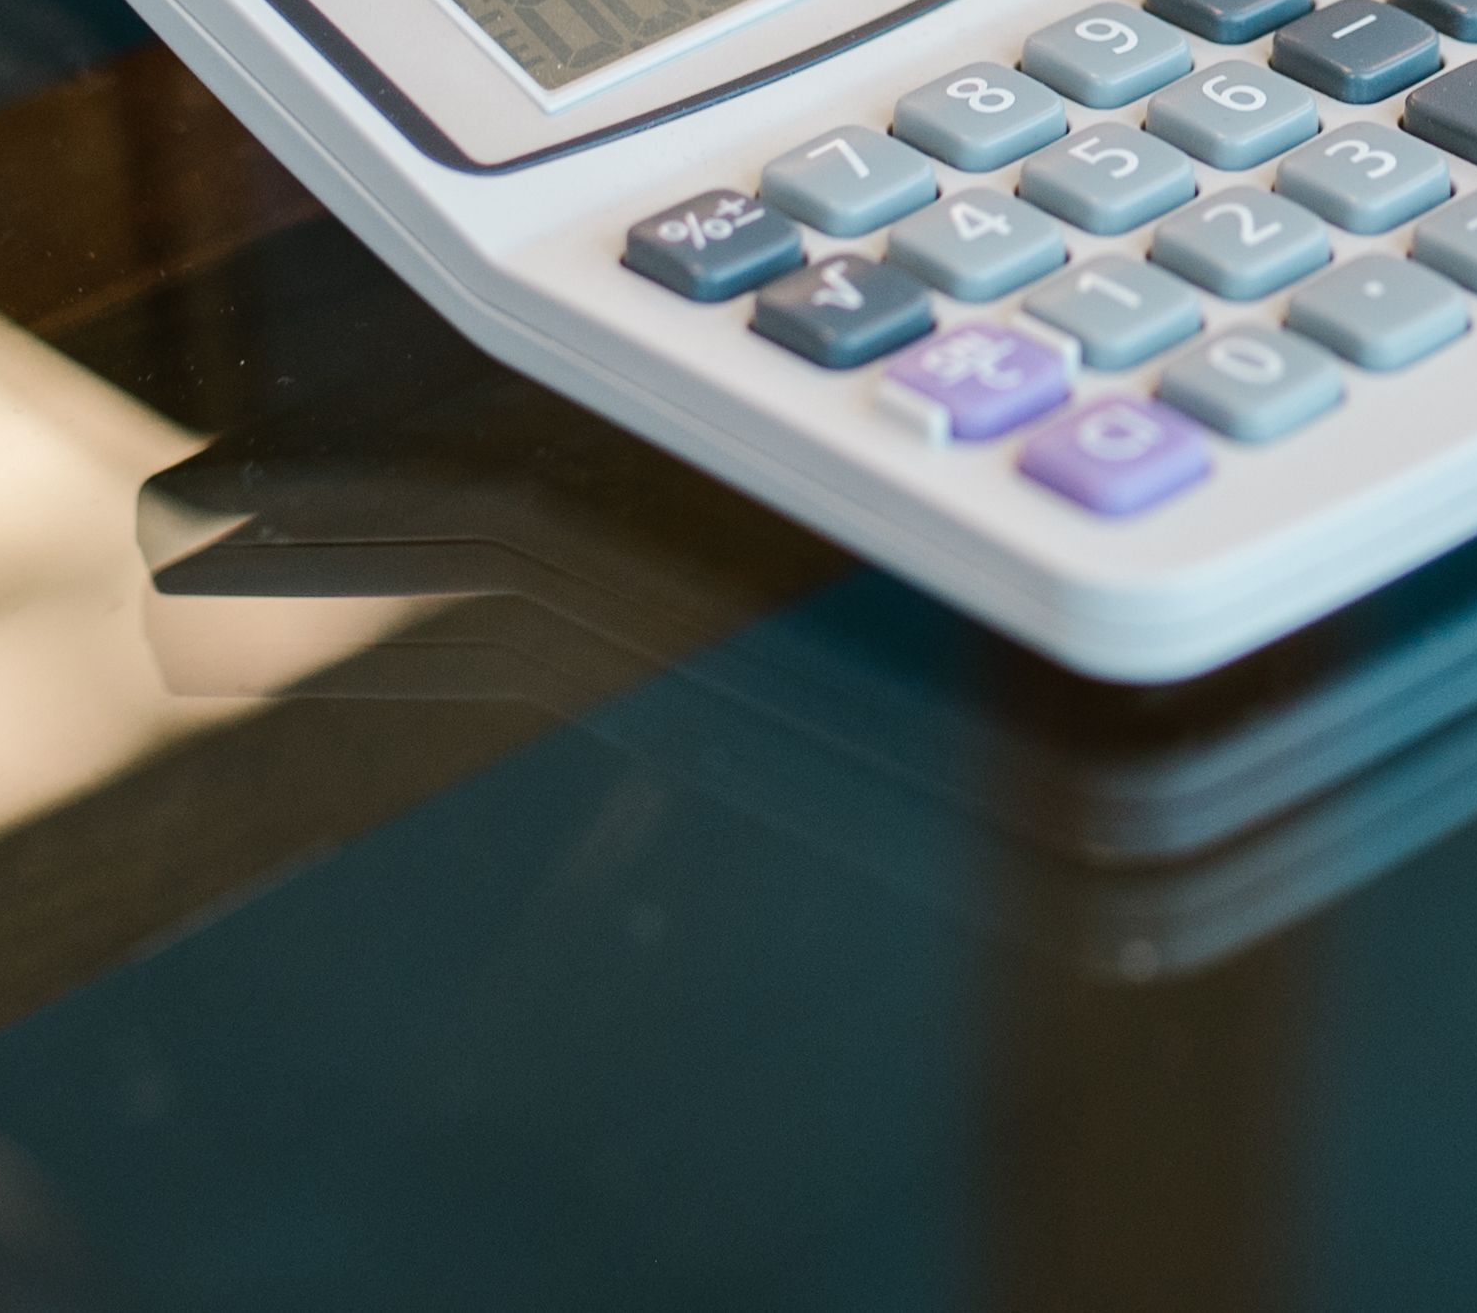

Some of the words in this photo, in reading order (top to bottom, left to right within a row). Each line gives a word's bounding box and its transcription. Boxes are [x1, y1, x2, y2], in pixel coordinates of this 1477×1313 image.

[1075, 16, 1140, 55] 9
[946, 77, 1016, 114] 8
[1201, 74, 1268, 112] 6
[806, 137, 871, 179] 7
[1068, 136, 1140, 179] 5
[1325, 138, 1397, 180] 3
[949, 201, 1012, 241] 4
[1202, 202, 1283, 247] 2
[1076, 271, 1141, 310] 1
[1208, 336, 1285, 384] 0
